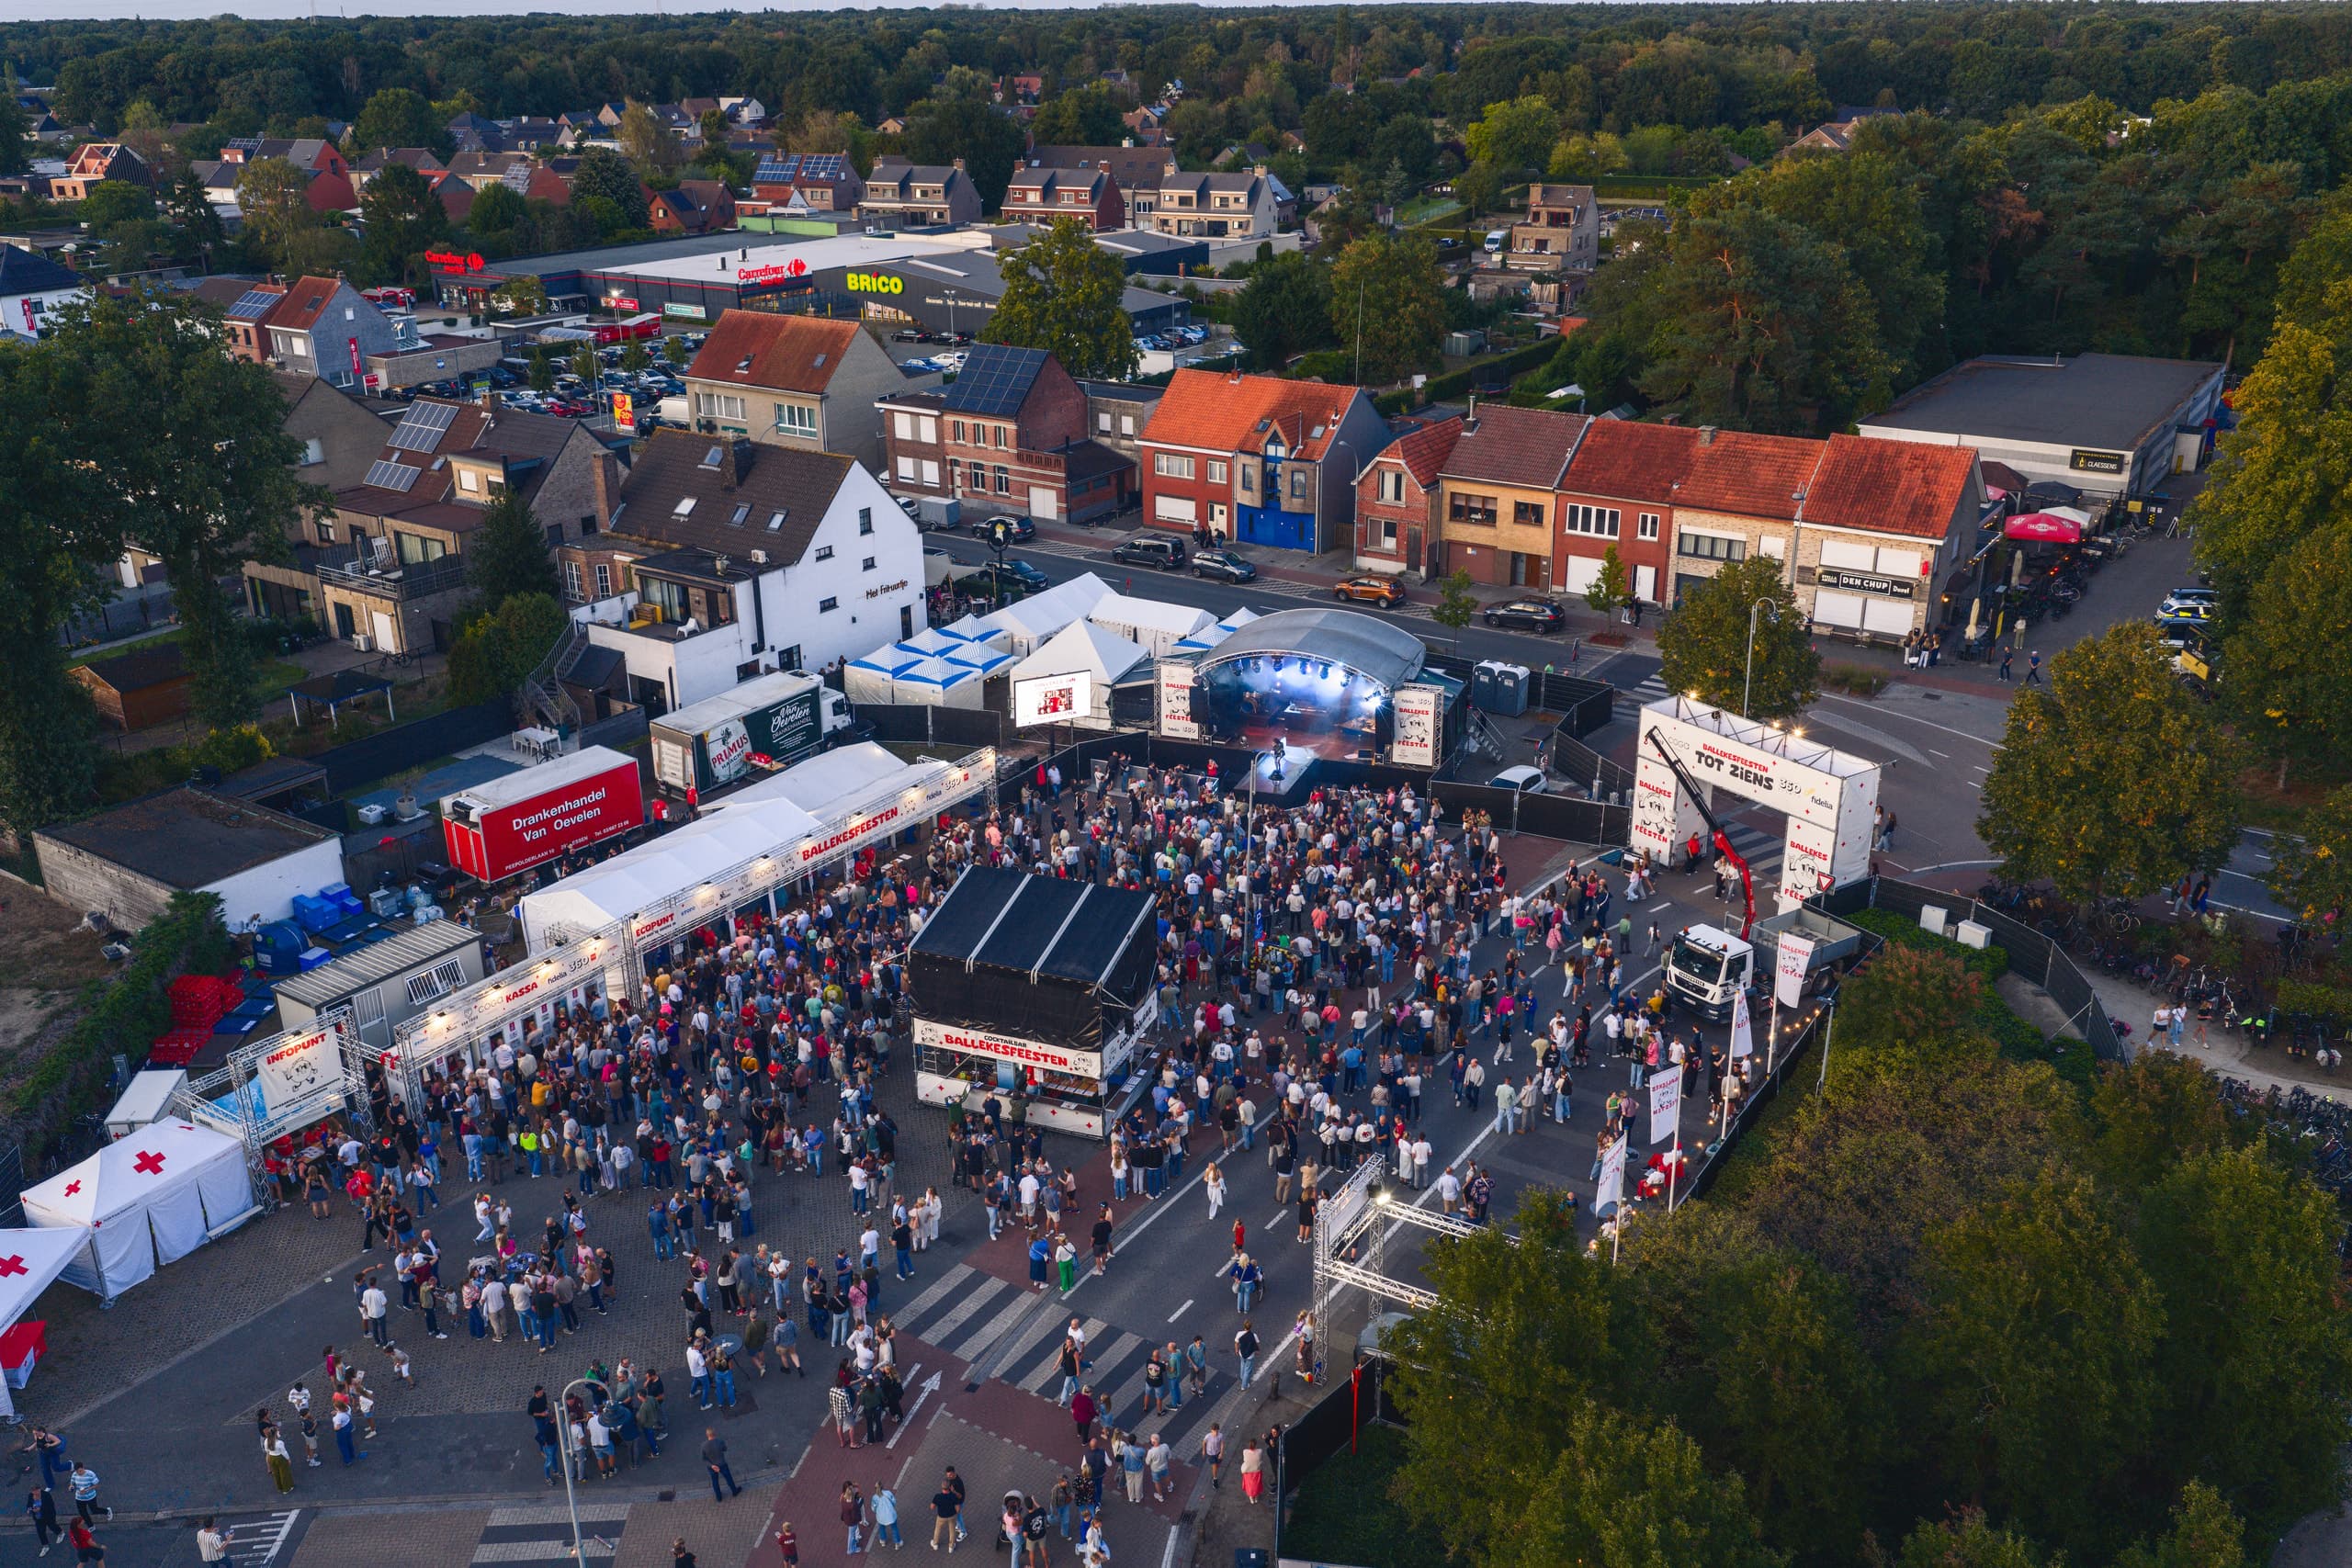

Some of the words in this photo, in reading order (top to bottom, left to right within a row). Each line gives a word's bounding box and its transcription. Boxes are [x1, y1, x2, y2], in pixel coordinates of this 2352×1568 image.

[738, 264, 785, 280] Carrefour
[2087, 460, 2117, 469] CLAESSENS
[1842, 576, 1861, 586] DEN
[1863, 580, 1888, 590] CHUP
[1398, 707, 1430, 716] BALLEKES
[710, 733, 749, 769] PRIMUS
[1397, 740, 1429, 749] FEESTEN
[721, 749, 745, 770] HAACHT
[1695, 750, 1724, 772] TOT
[1702, 742, 1769, 773] BALLEKESFEESTEN
[1639, 779, 1672, 798] BALLEKES
[512, 786, 607, 830] Drankenhandel
[1811, 795, 1834, 810] fidelia
[523, 828, 548, 842] Van
[553, 807, 602, 830] Oevelen
[802, 807, 899, 862] BALLEKESFEESTEN
[1635, 824, 1668, 843] FEESTEN
[1790, 840, 1828, 861] BALLEKES
[1784, 888, 1806, 902] FEES
[636, 913, 675, 938] ECOPUNT
[505, 981, 538, 1003] KASSA
[548, 971, 568, 985] fidelia
[944, 1033, 1069, 1066] BALLEKESFEESTEN
[262, 1125, 287, 1143] BEKERS
